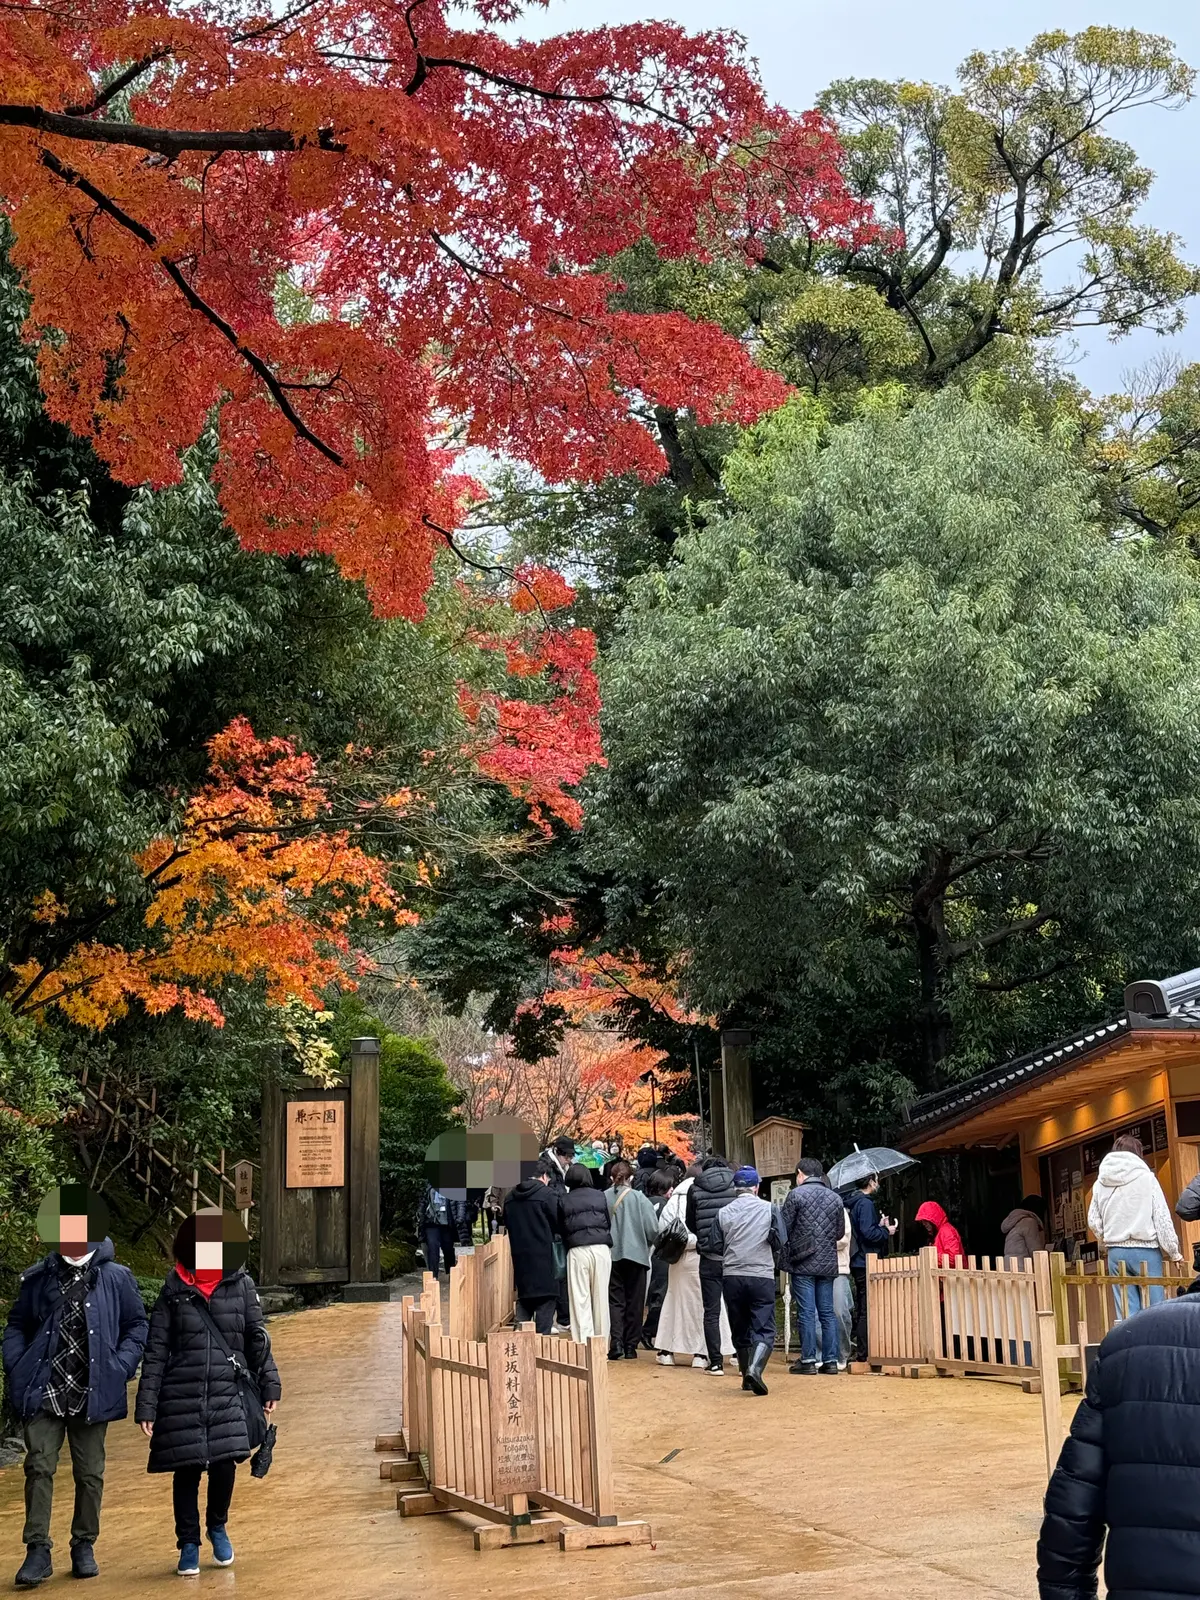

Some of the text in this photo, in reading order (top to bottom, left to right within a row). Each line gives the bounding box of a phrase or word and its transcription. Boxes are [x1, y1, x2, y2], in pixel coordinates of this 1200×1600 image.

[295, 1109, 336, 1124] 兼六園
[504, 1342, 521, 1426] 桂坂料金所
